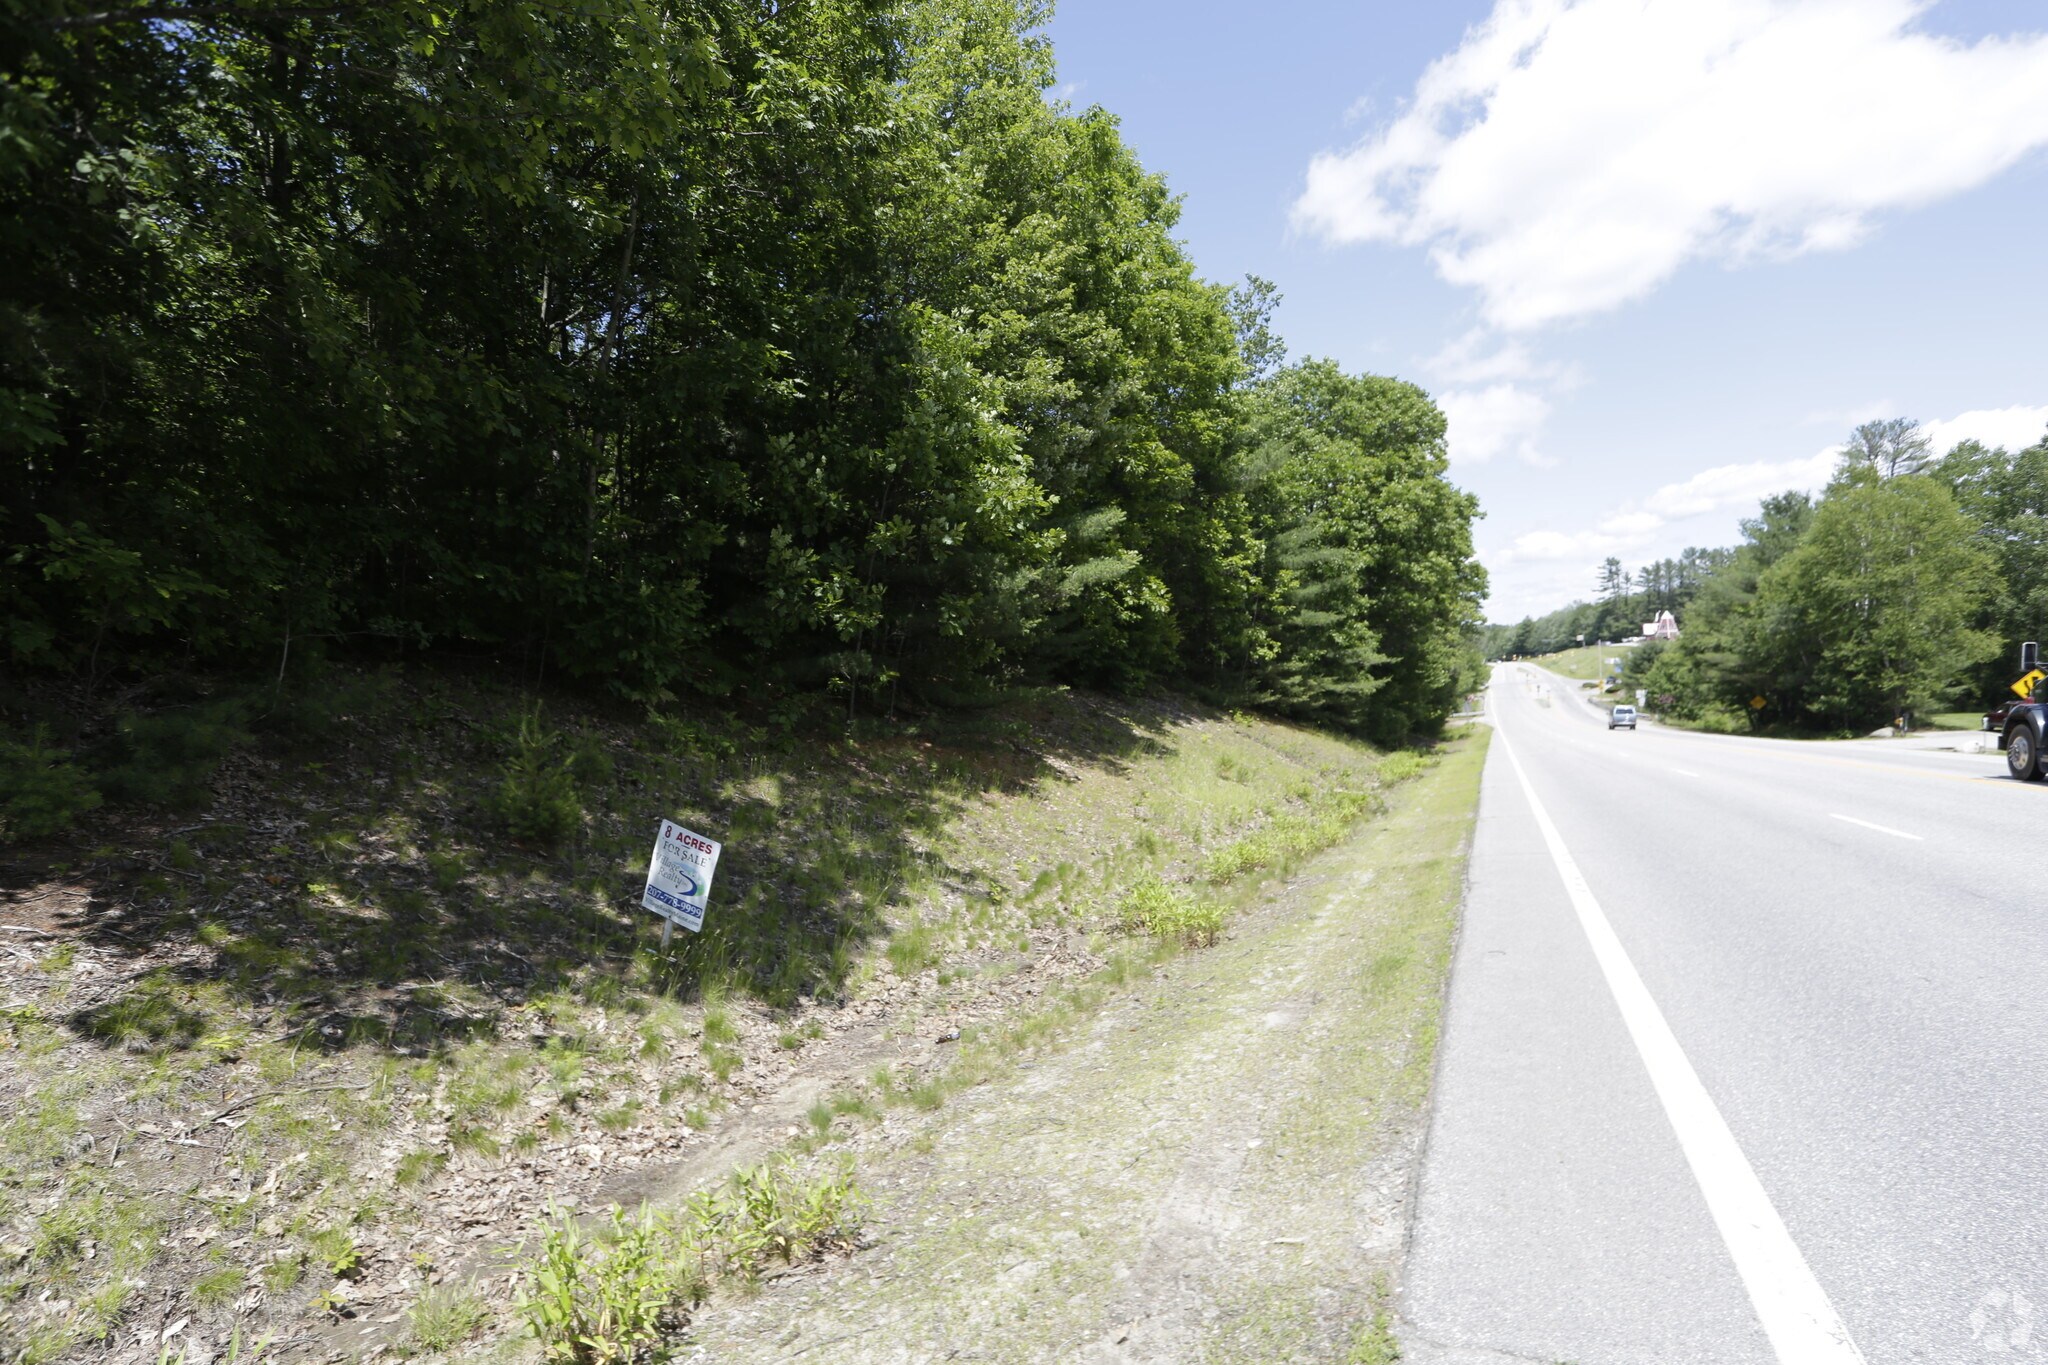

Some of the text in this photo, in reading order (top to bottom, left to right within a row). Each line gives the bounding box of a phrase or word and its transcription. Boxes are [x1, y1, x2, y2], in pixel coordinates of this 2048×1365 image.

[664, 825, 712, 855] 8 ACRES
[655, 852, 681, 872] Village
[663, 841, 706, 868] FOR SALE
[657, 867, 683, 887] Realty
[647, 886, 702, 918] 207-778-9999
